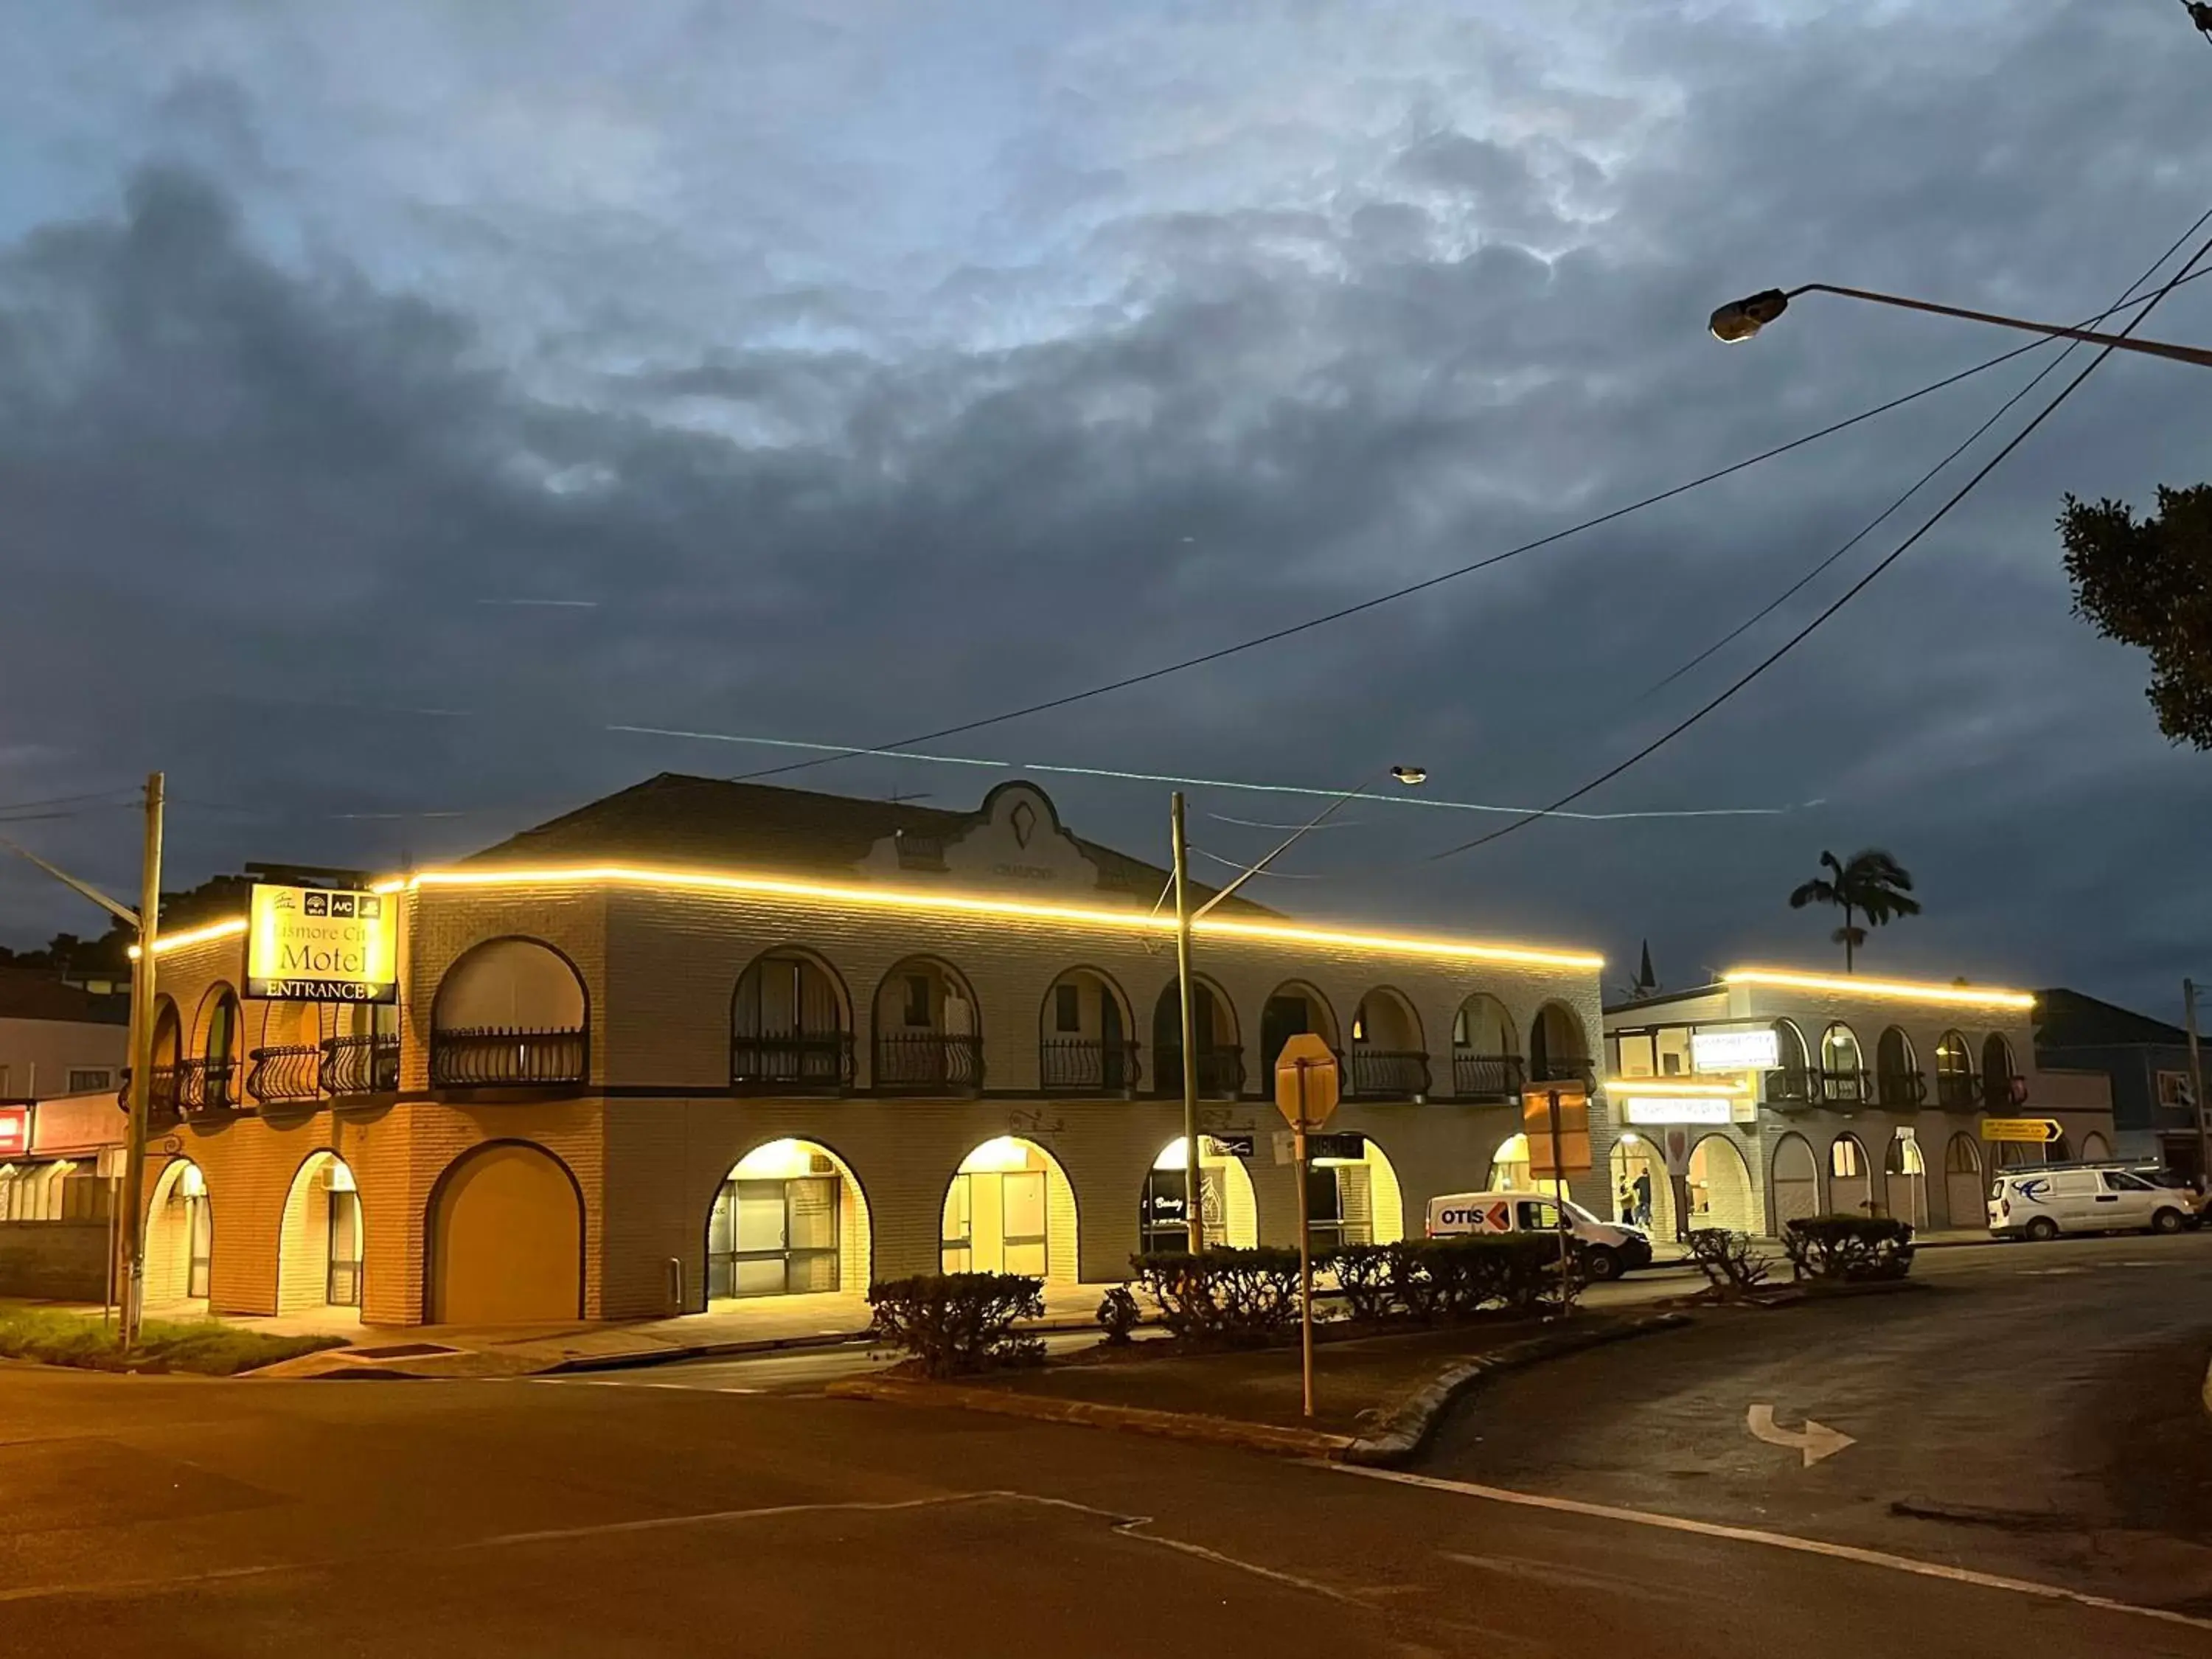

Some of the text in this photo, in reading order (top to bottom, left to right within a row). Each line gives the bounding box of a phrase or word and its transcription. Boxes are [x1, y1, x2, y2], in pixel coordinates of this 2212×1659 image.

[333, 901, 352, 912] A/C
[279, 945, 366, 973] Motel
[266, 981, 365, 1000] ENTRANCE
[1441, 1209, 1484, 1224] OTIS
